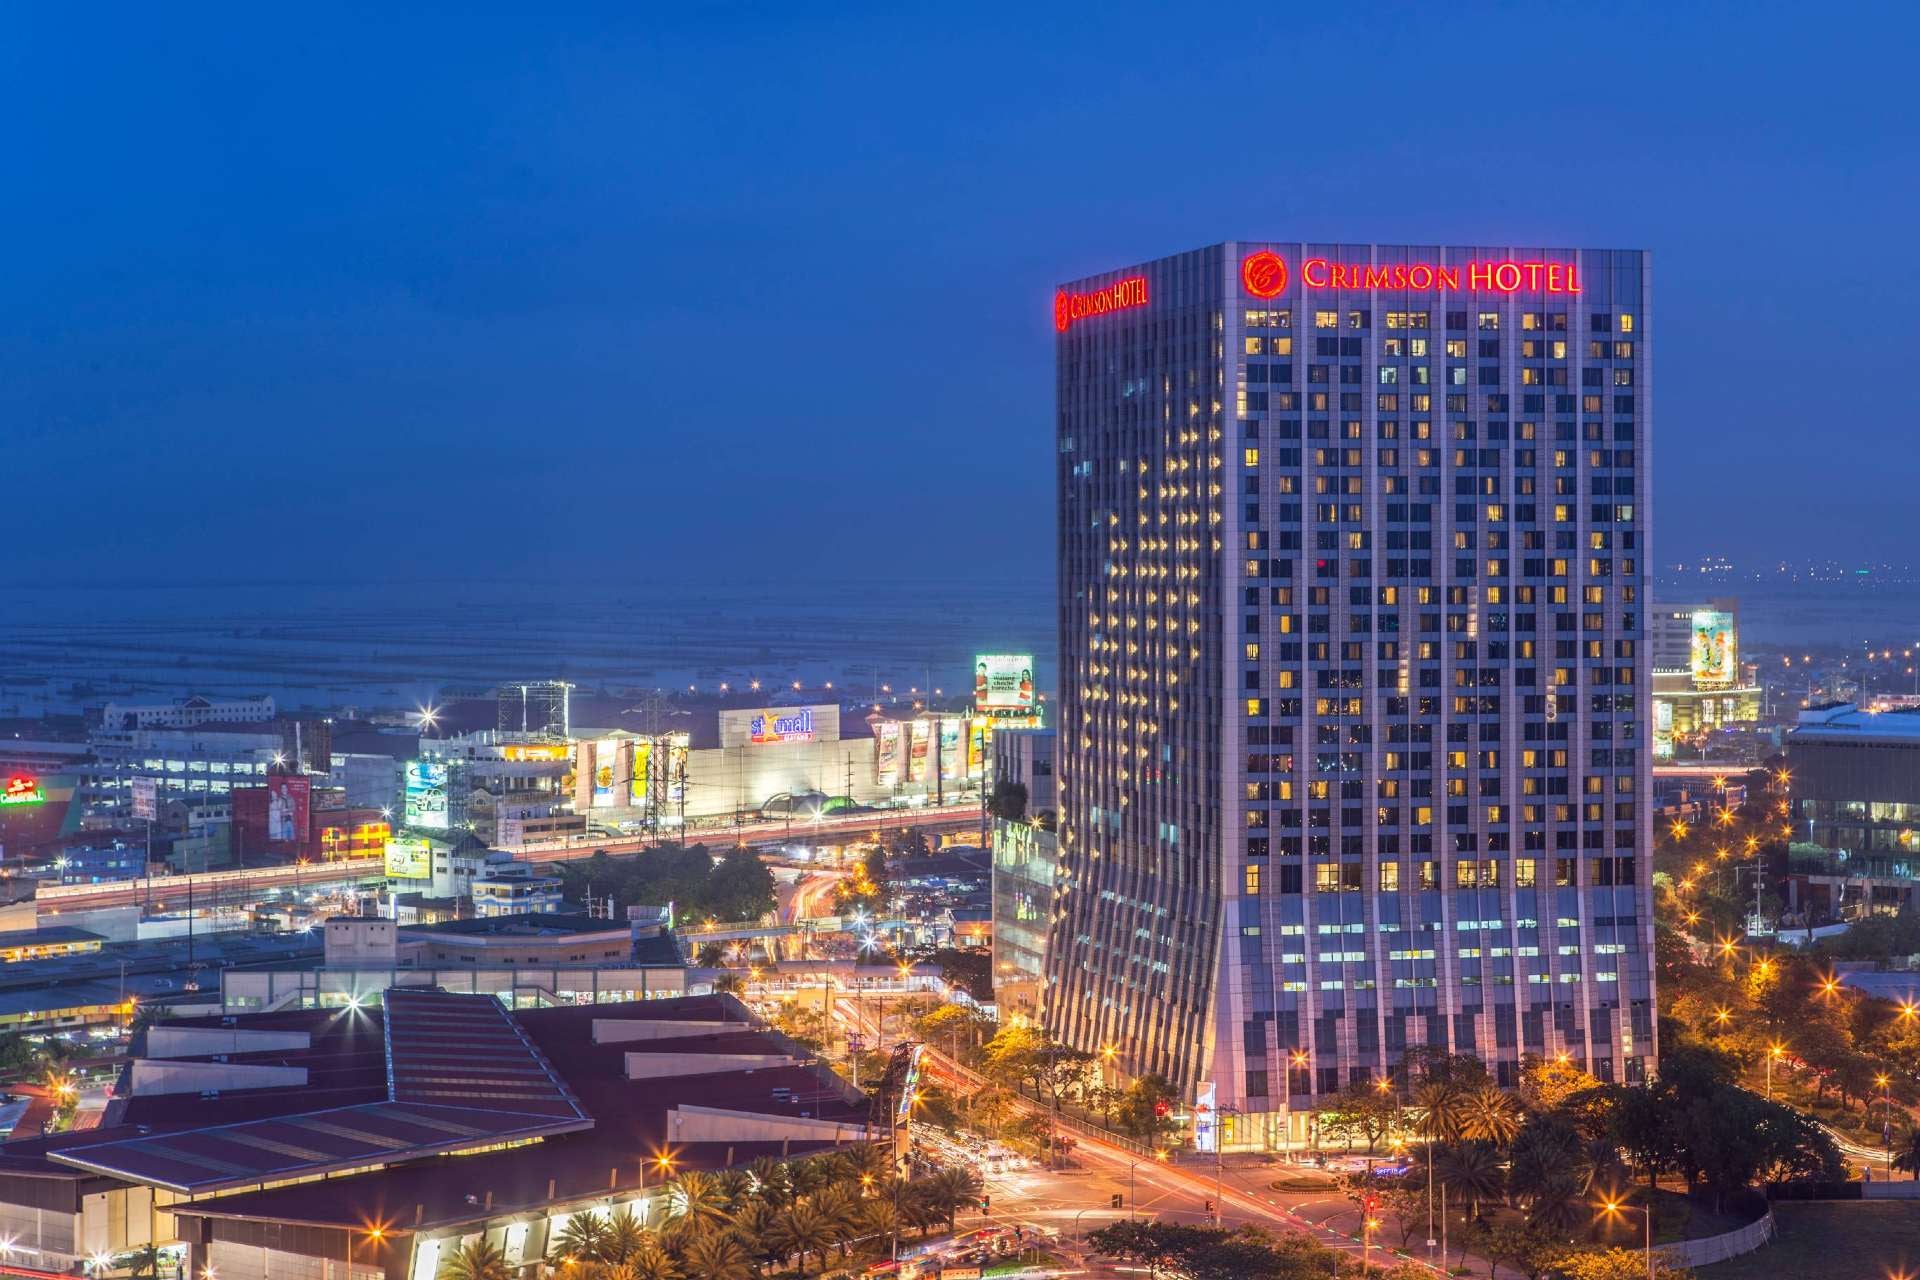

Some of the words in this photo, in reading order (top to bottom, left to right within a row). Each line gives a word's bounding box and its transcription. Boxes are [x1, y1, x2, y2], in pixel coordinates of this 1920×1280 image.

[1303, 259, 1459, 290] CRIMSON
[1470, 263, 1582, 292] HOTEL
[1070, 288, 1113, 319] CRIMSON
[1113, 278, 1148, 309] HOTEL
